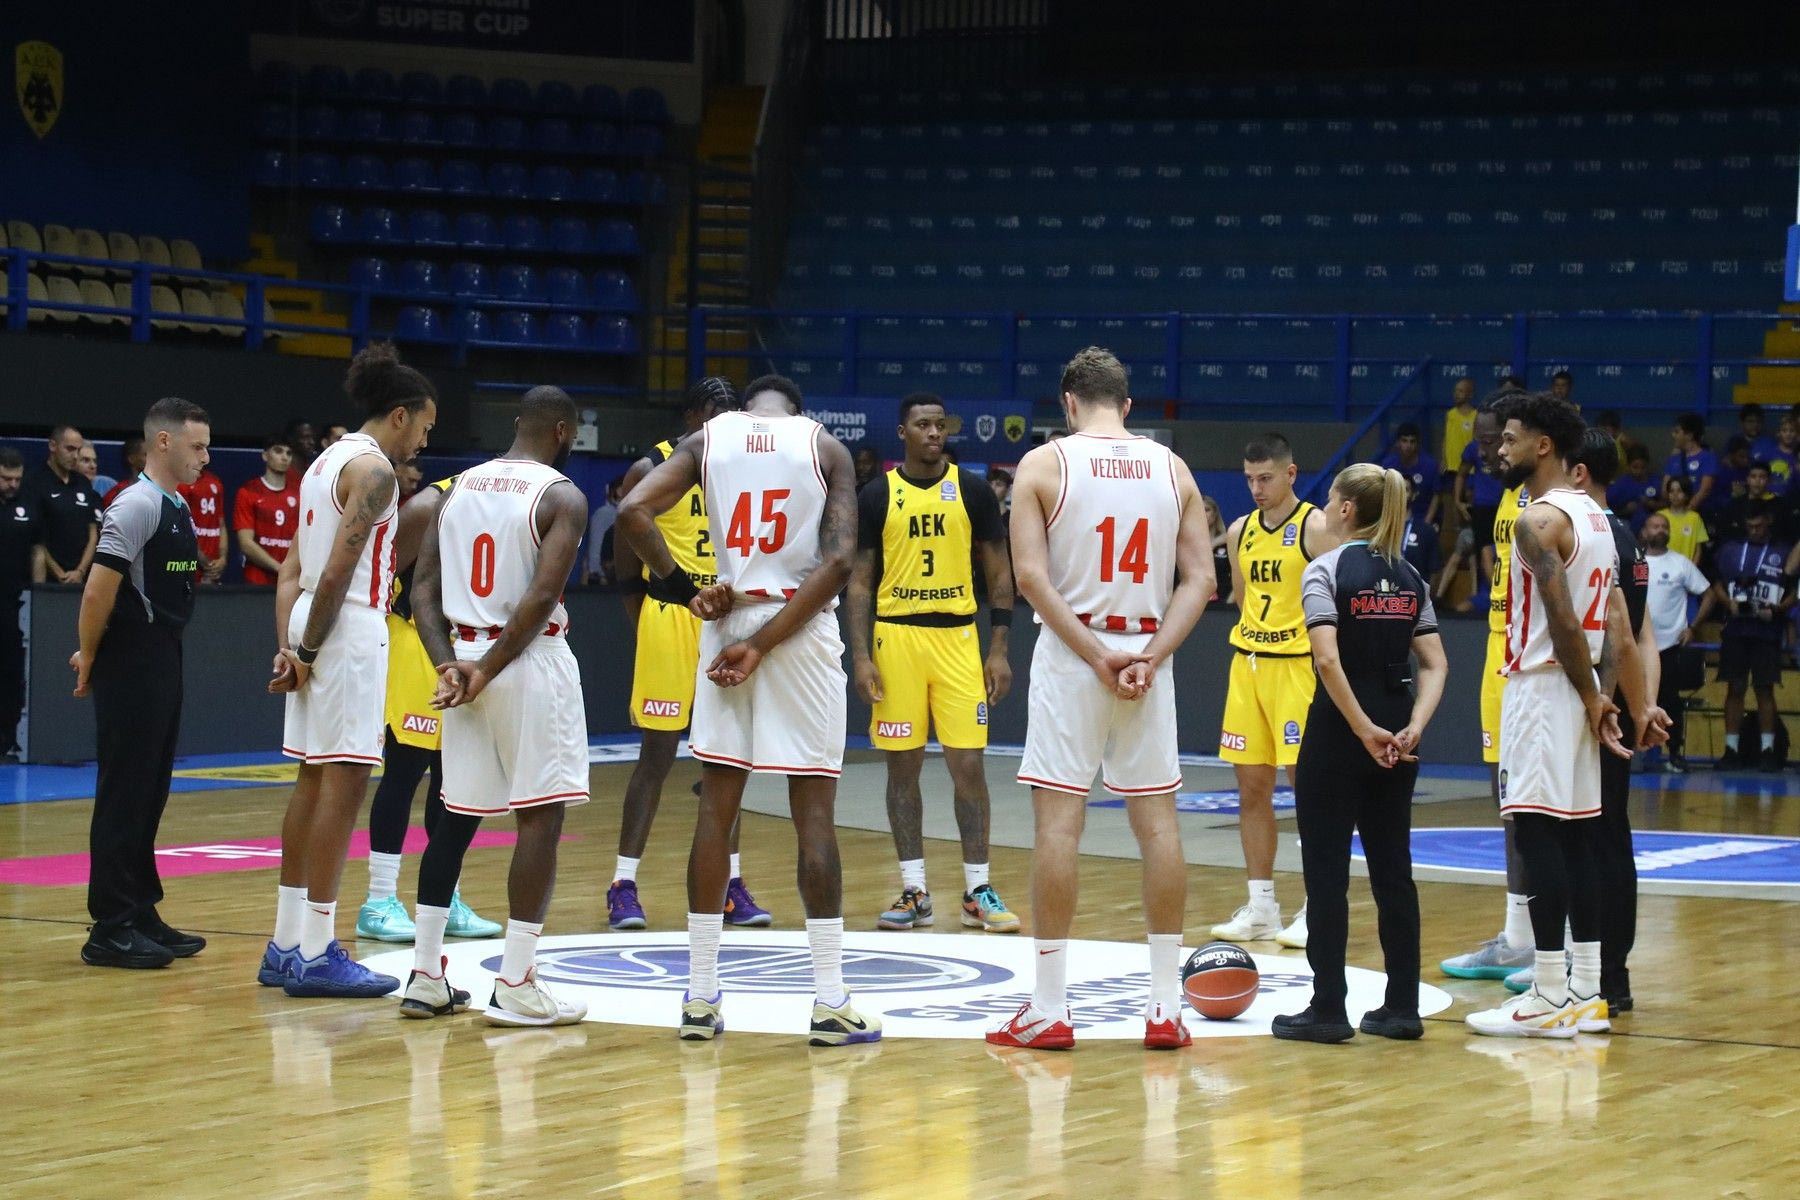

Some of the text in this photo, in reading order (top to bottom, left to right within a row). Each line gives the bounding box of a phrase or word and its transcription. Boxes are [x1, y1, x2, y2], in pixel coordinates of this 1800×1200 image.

[377, 7, 530, 36] SUPER CUP
[747, 434, 776, 453] HALL
[832, 426, 866, 441] CUP
[1090, 458, 1151, 479] VEZENKOV
[200, 498, 216, 515] 94
[275, 509, 285, 526] 9
[725, 489, 791, 557] 45
[909, 514, 945, 538] AEK
[696, 530, 716, 557] 2
[1095, 516, 1149, 584] 14
[470, 532, 495, 598] 0
[921, 549, 934, 577] 3
[1250, 560, 1282, 582] AEK
[891, 585, 965, 601] SUPERBET
[1260, 594, 1272, 622] 7
[643, 700, 680, 716] AVIS
[403, 715, 438, 734] AVIS
[879, 722, 911, 737] AVIS
